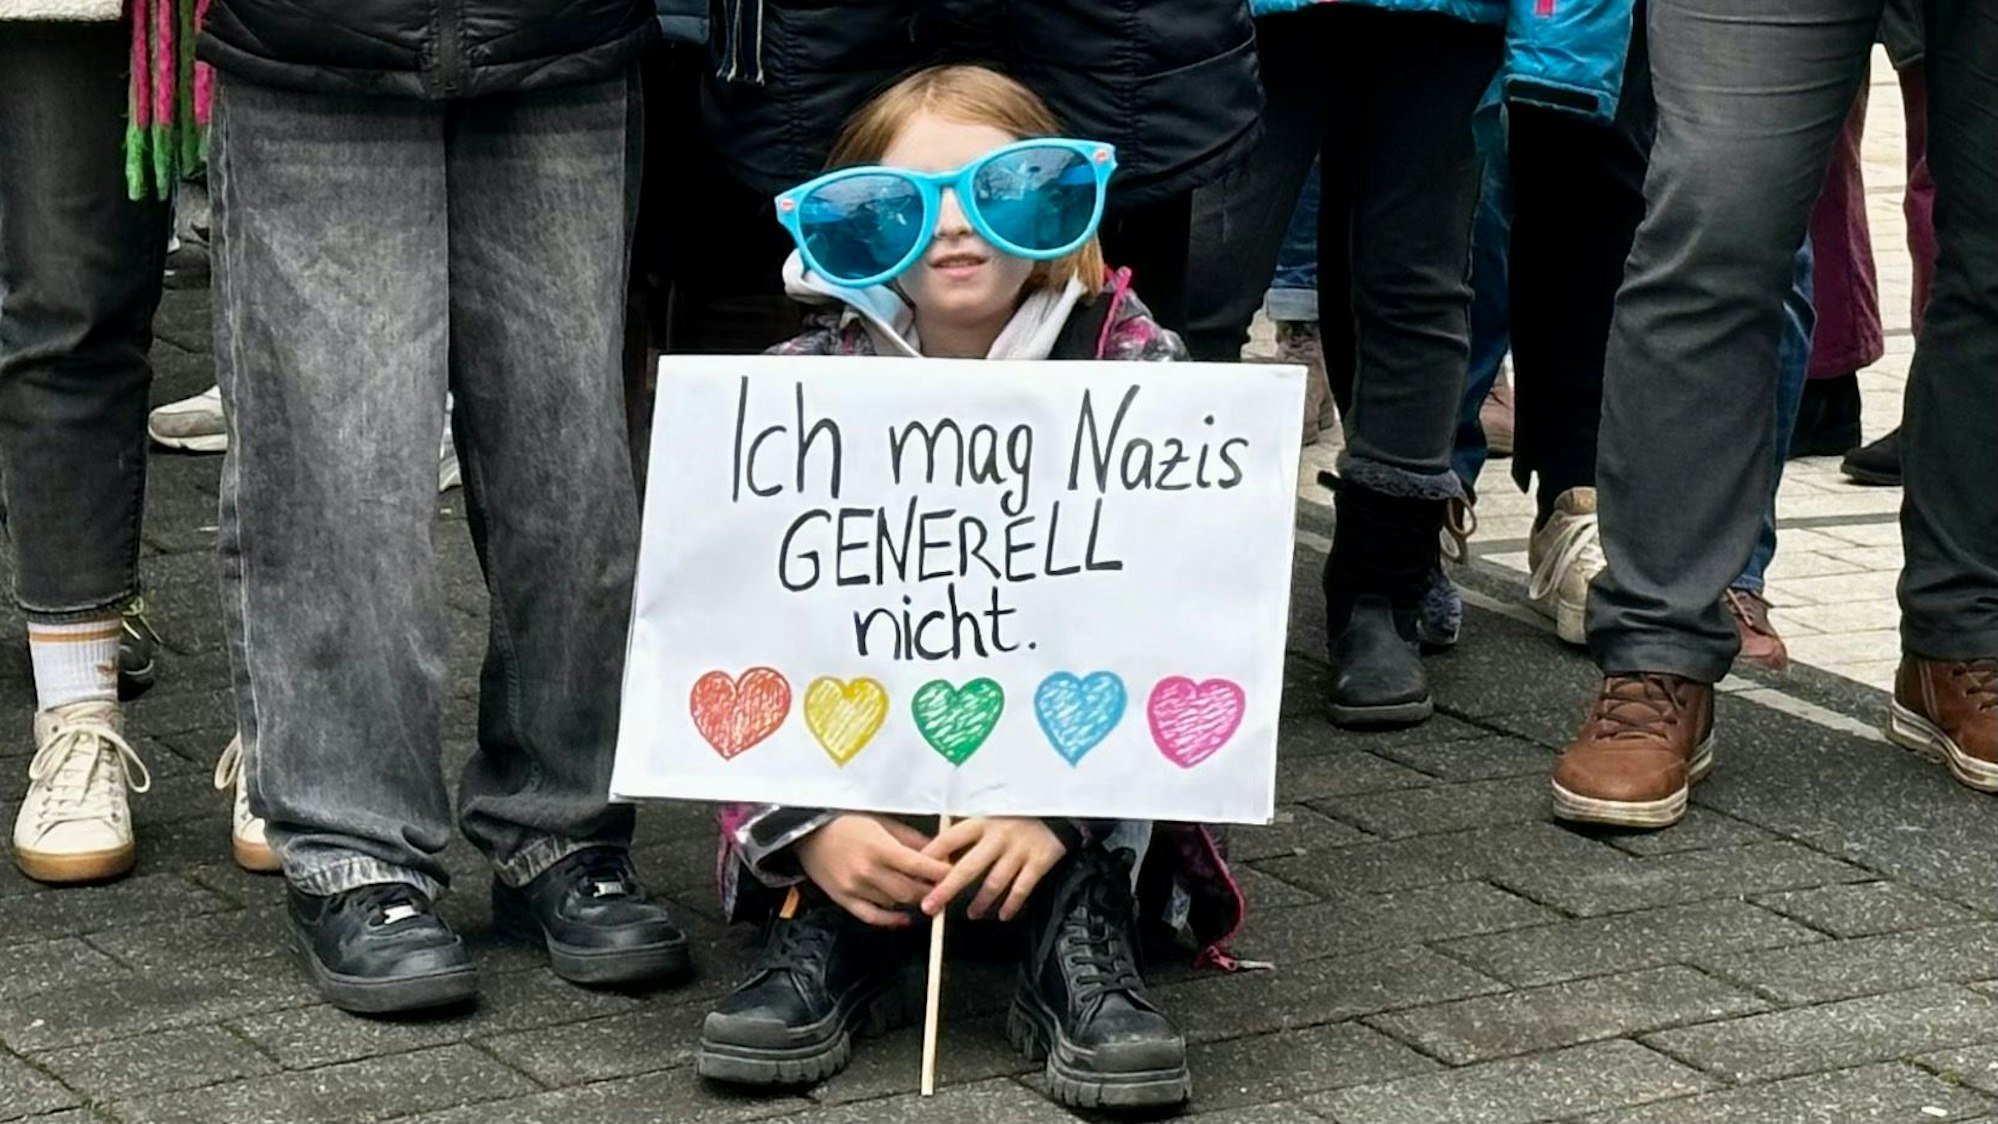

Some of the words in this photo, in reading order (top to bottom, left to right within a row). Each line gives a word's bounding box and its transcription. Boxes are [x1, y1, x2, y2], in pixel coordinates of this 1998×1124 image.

[733, 376, 842, 502] Ich
[889, 418, 1033, 518] mag
[1068, 384, 1249, 493] Nazis
[779, 496, 1124, 593] GENERELL
[854, 583, 1037, 662] nicht.
